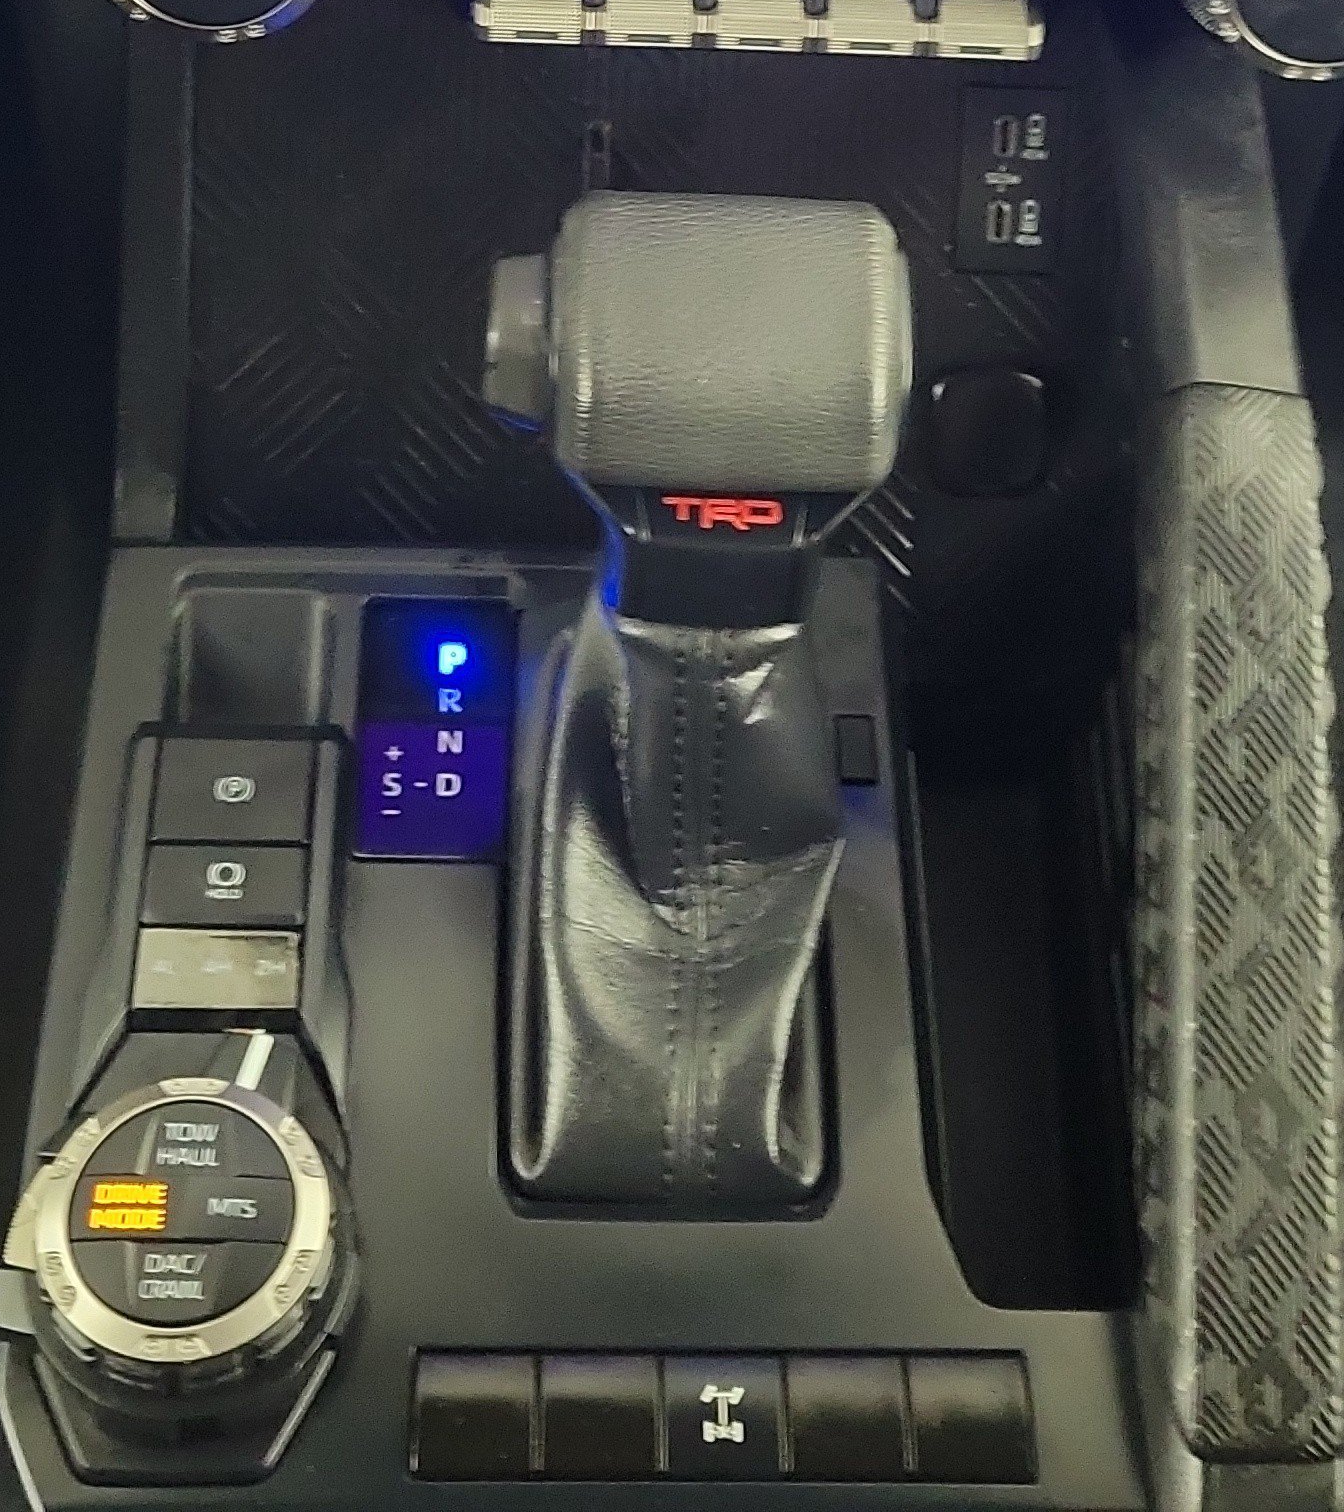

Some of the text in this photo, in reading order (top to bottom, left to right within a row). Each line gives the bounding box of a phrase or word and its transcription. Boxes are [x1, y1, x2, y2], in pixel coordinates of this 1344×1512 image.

[661, 495, 784, 531] TRD
[437, 641, 468, 675] P
[437, 688, 464, 713] R
[436, 730, 464, 754] N
[435, 772, 462, 797] D
[156, 1146, 220, 1167] HAUL
[92, 1183, 169, 1206] DRIVE
[88, 1207, 167, 1230] MODE
[207, 1197, 258, 1219] MTS
[144, 1253, 207, 1275] DAC/
[138, 1278, 205, 1300] CRAWL
